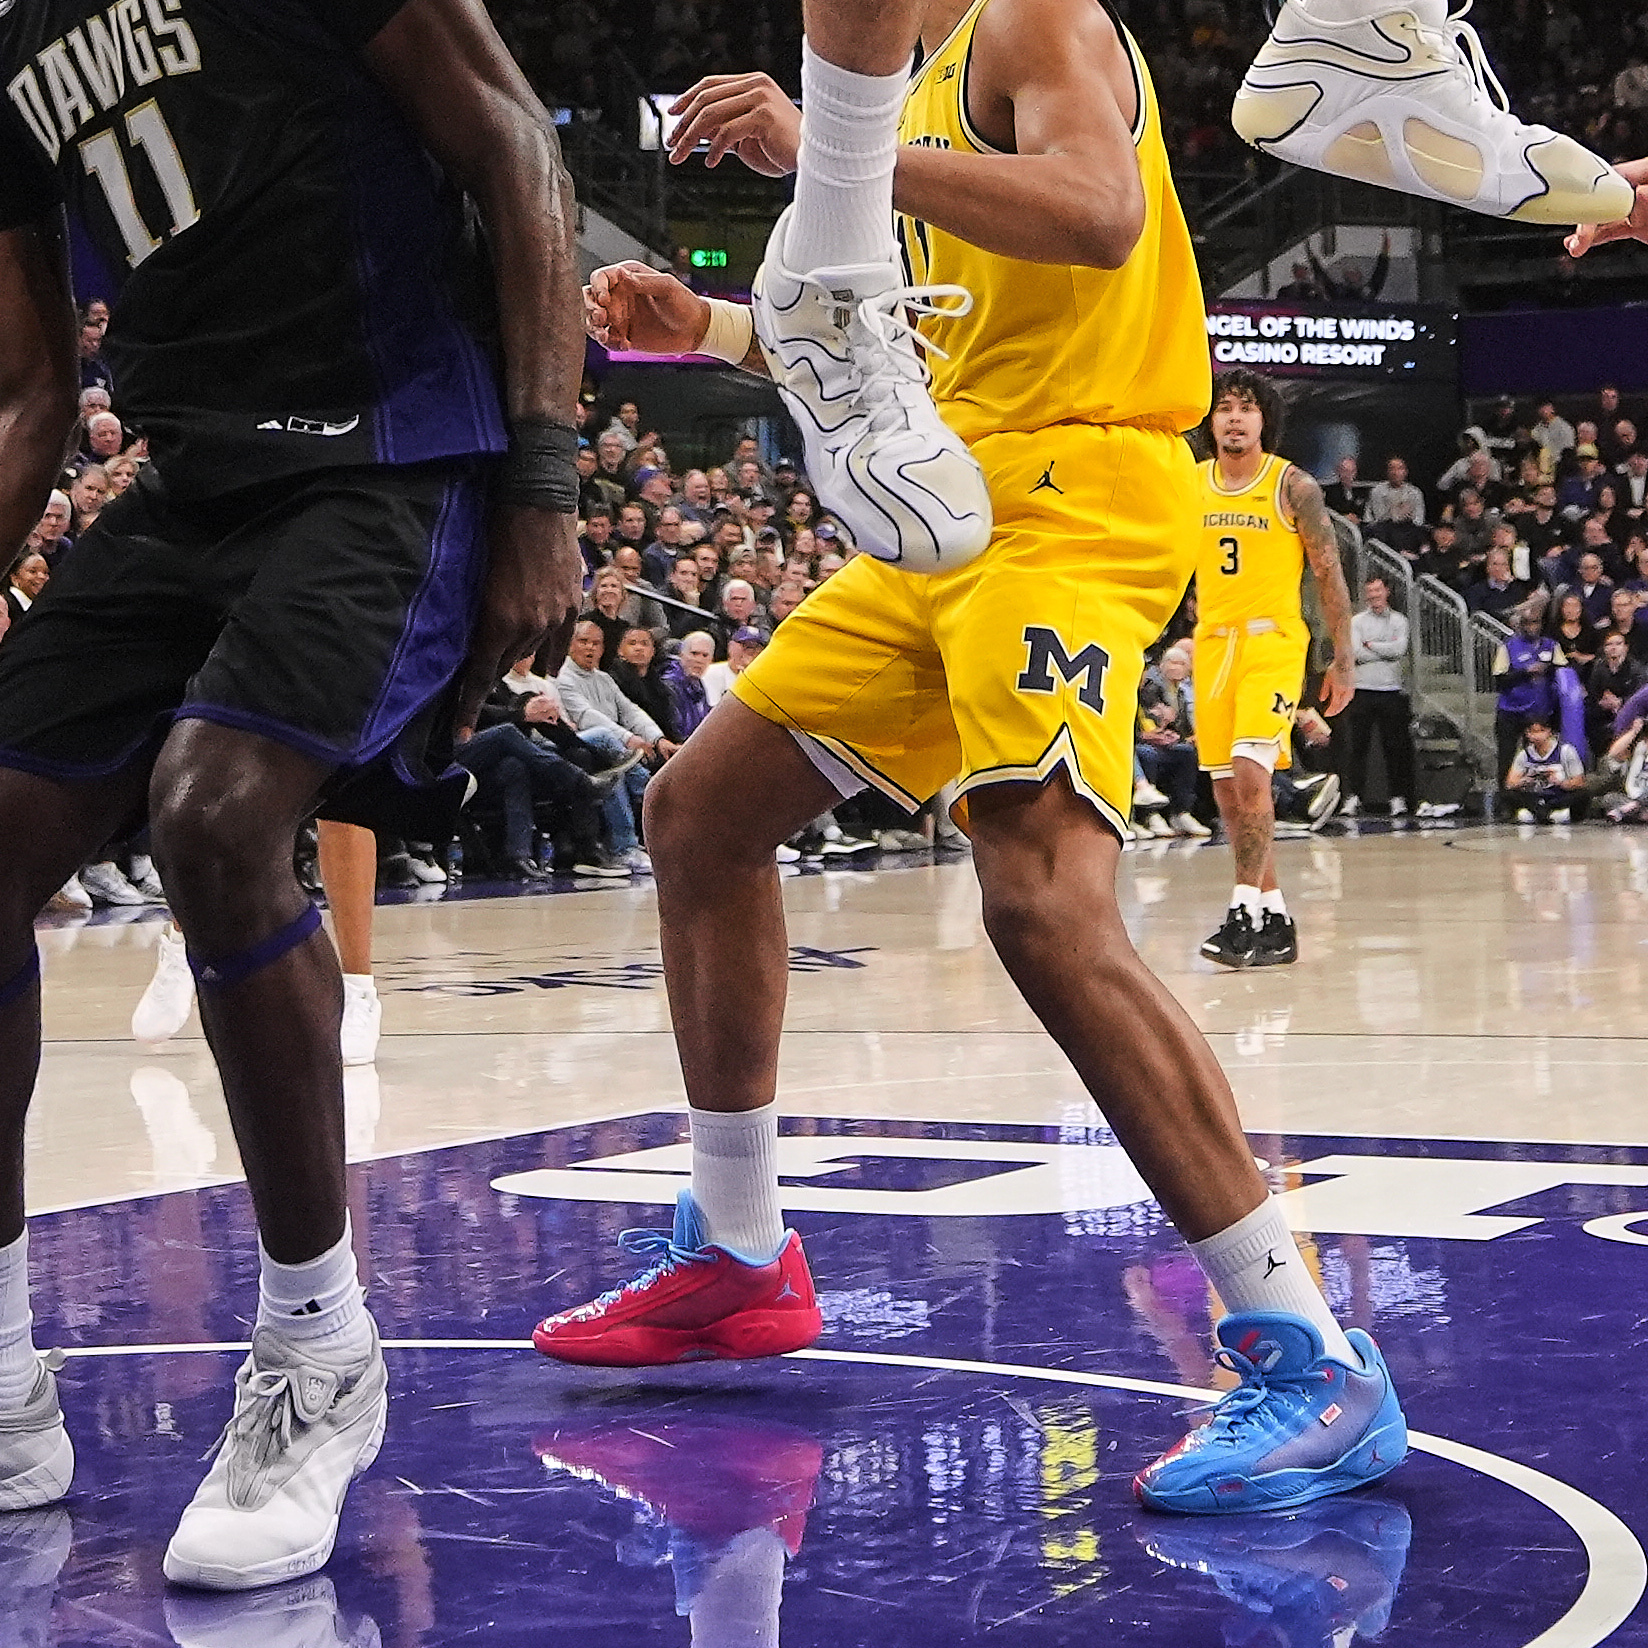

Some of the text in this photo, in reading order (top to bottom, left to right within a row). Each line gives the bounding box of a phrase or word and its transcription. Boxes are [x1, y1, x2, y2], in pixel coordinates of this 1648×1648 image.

[76, 97, 202, 269] 11
[1207, 315, 1416, 342] NGEL OF THE WINDS
[1214, 340, 1387, 366] CASINO RESORT
[1203, 513, 1269, 531] ICHIGAN
[1218, 537, 1242, 575] 3
[1017, 625, 1109, 716] M
